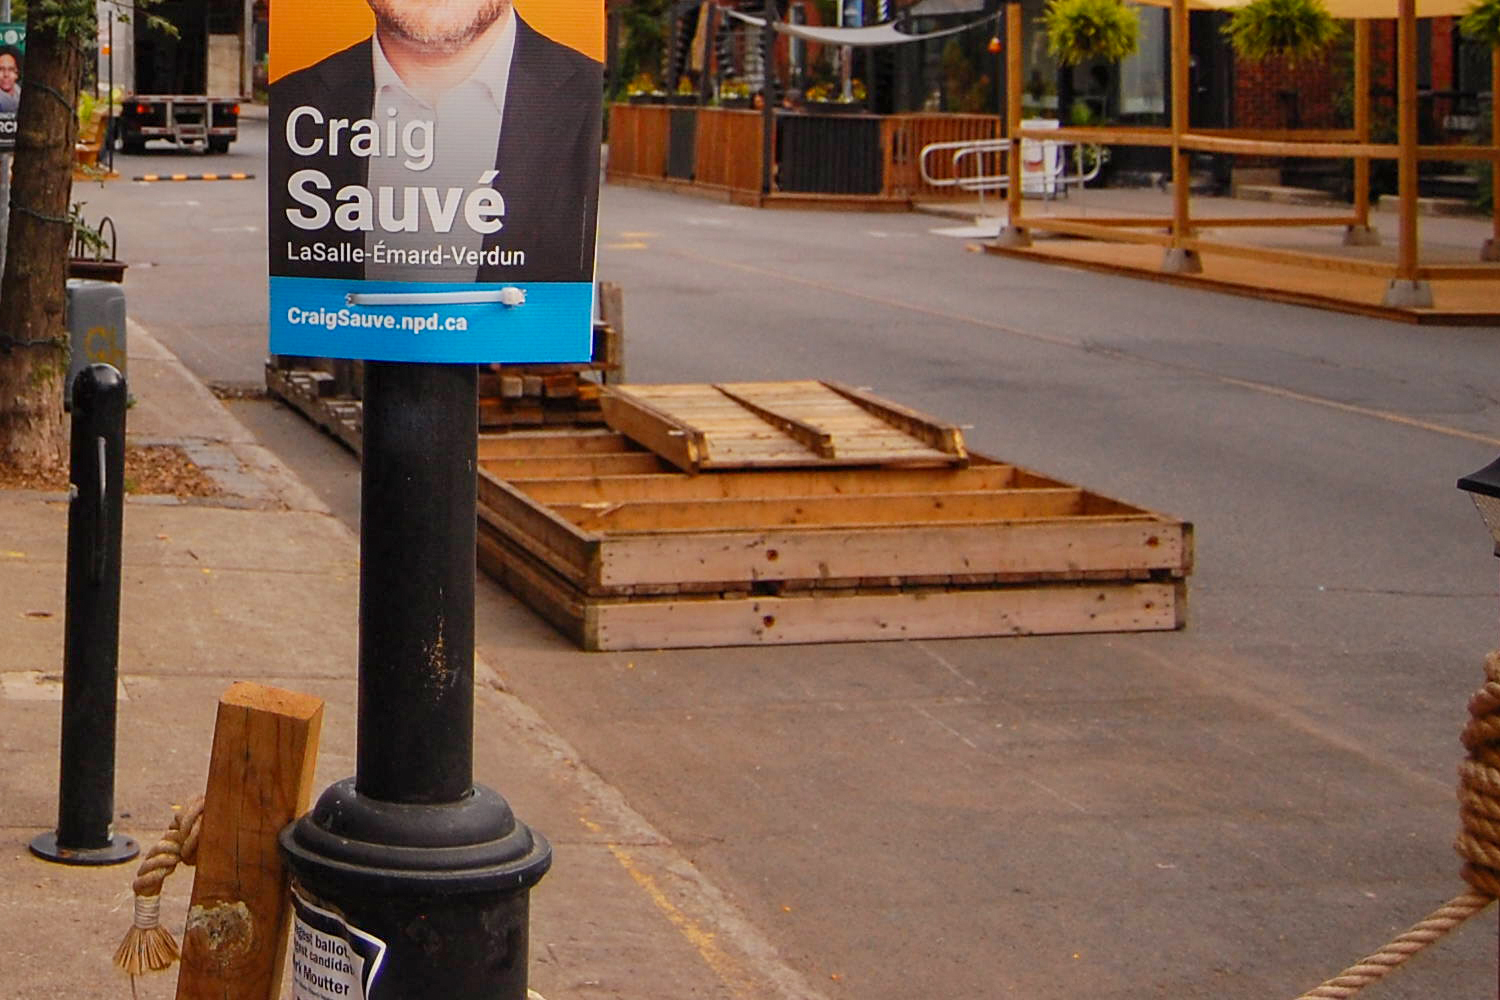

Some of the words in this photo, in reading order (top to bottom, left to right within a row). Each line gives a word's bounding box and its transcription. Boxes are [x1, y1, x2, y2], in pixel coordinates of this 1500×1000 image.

[285, 105, 436, 171] Craig
[285, 169, 506, 234] Sauvé
[287, 241, 526, 265] LaSalle-Émard-Verdun
[287, 307, 468, 334] CraigSauve.npd.ca
[303, 965, 350, 996] Moutter
